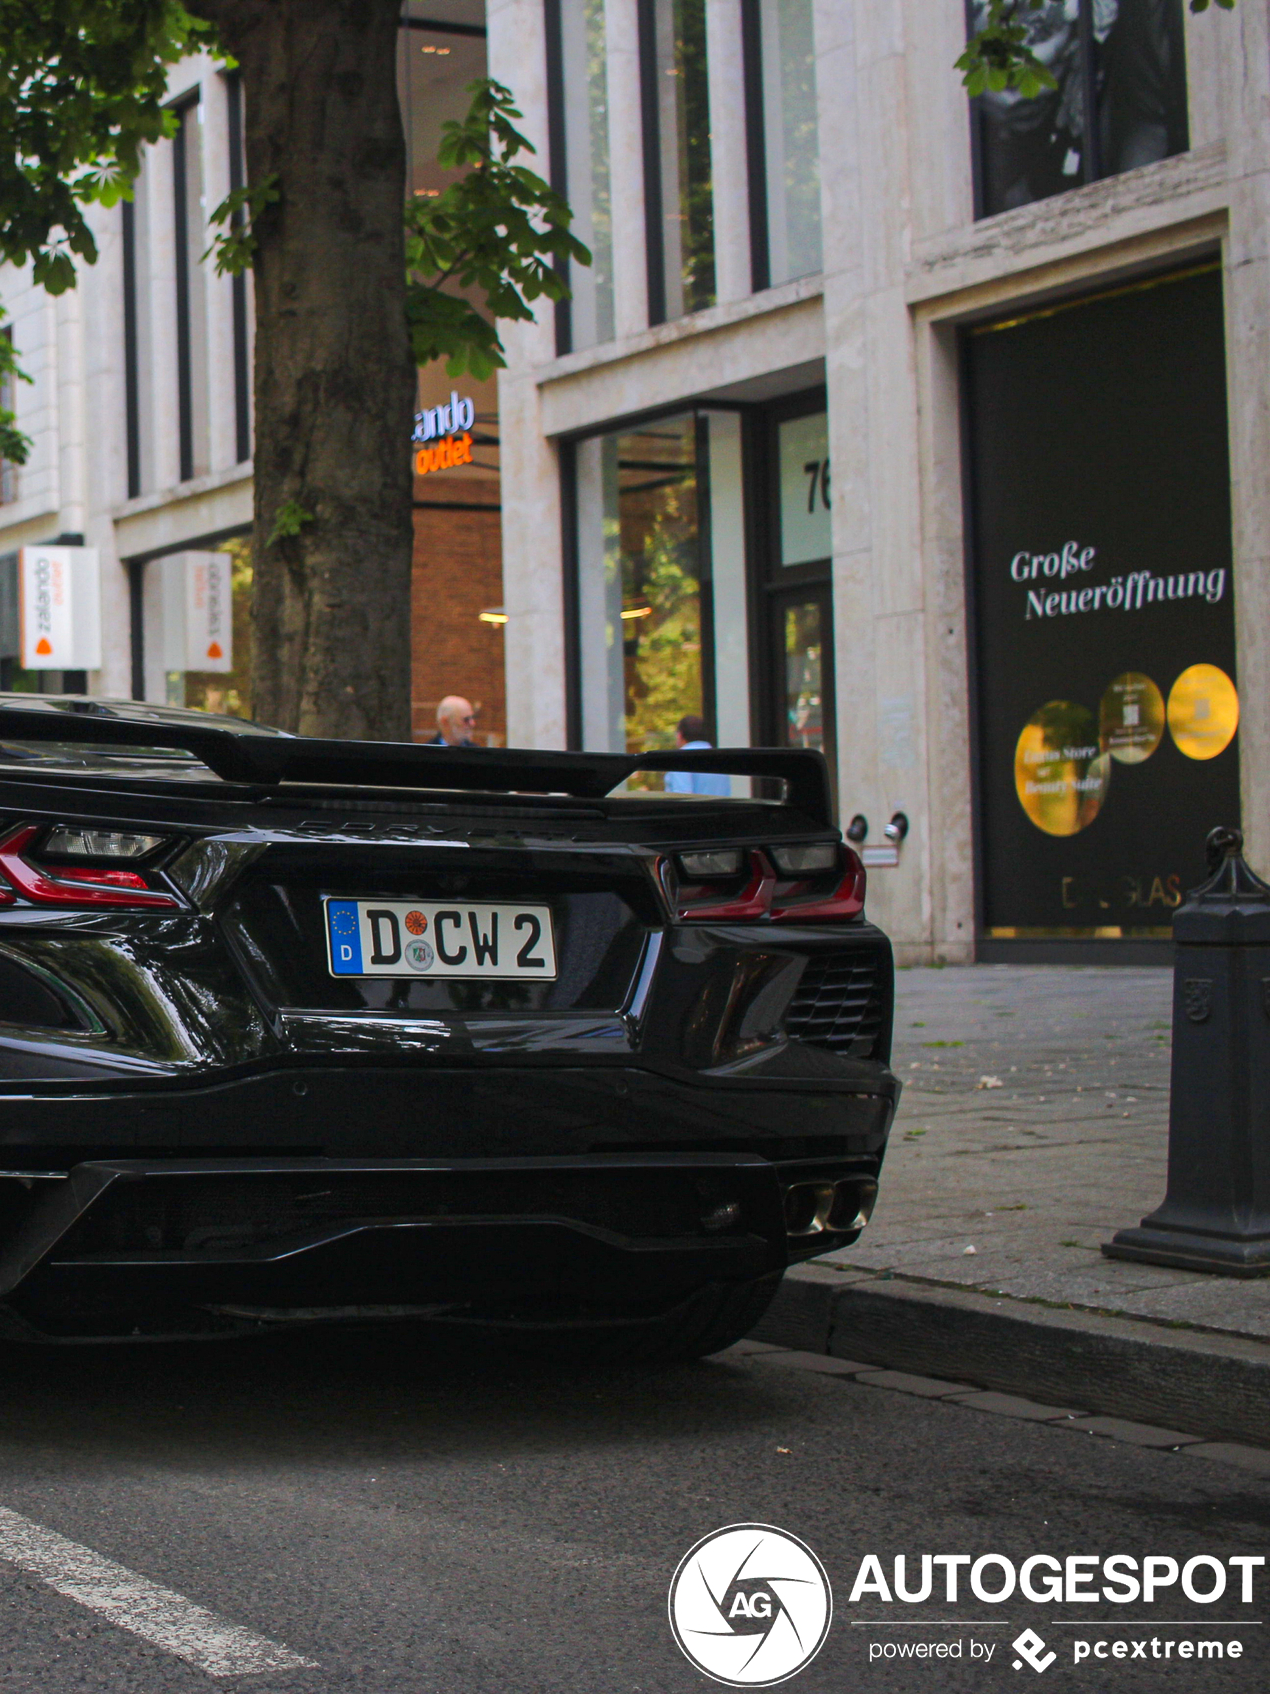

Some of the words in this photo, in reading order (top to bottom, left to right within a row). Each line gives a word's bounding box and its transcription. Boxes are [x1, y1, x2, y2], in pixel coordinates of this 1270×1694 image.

[411, 390, 474, 442] ando
[416, 431, 473, 474] outlet
[1010, 540, 1096, 582] Große
[34, 557, 51, 632] zalando
[1025, 568, 1225, 620] Neueröffnung
[340, 944, 352, 961] D
[366, 909, 402, 965] D
[433, 910, 498, 967] CW
[513, 913, 545, 968] 2
